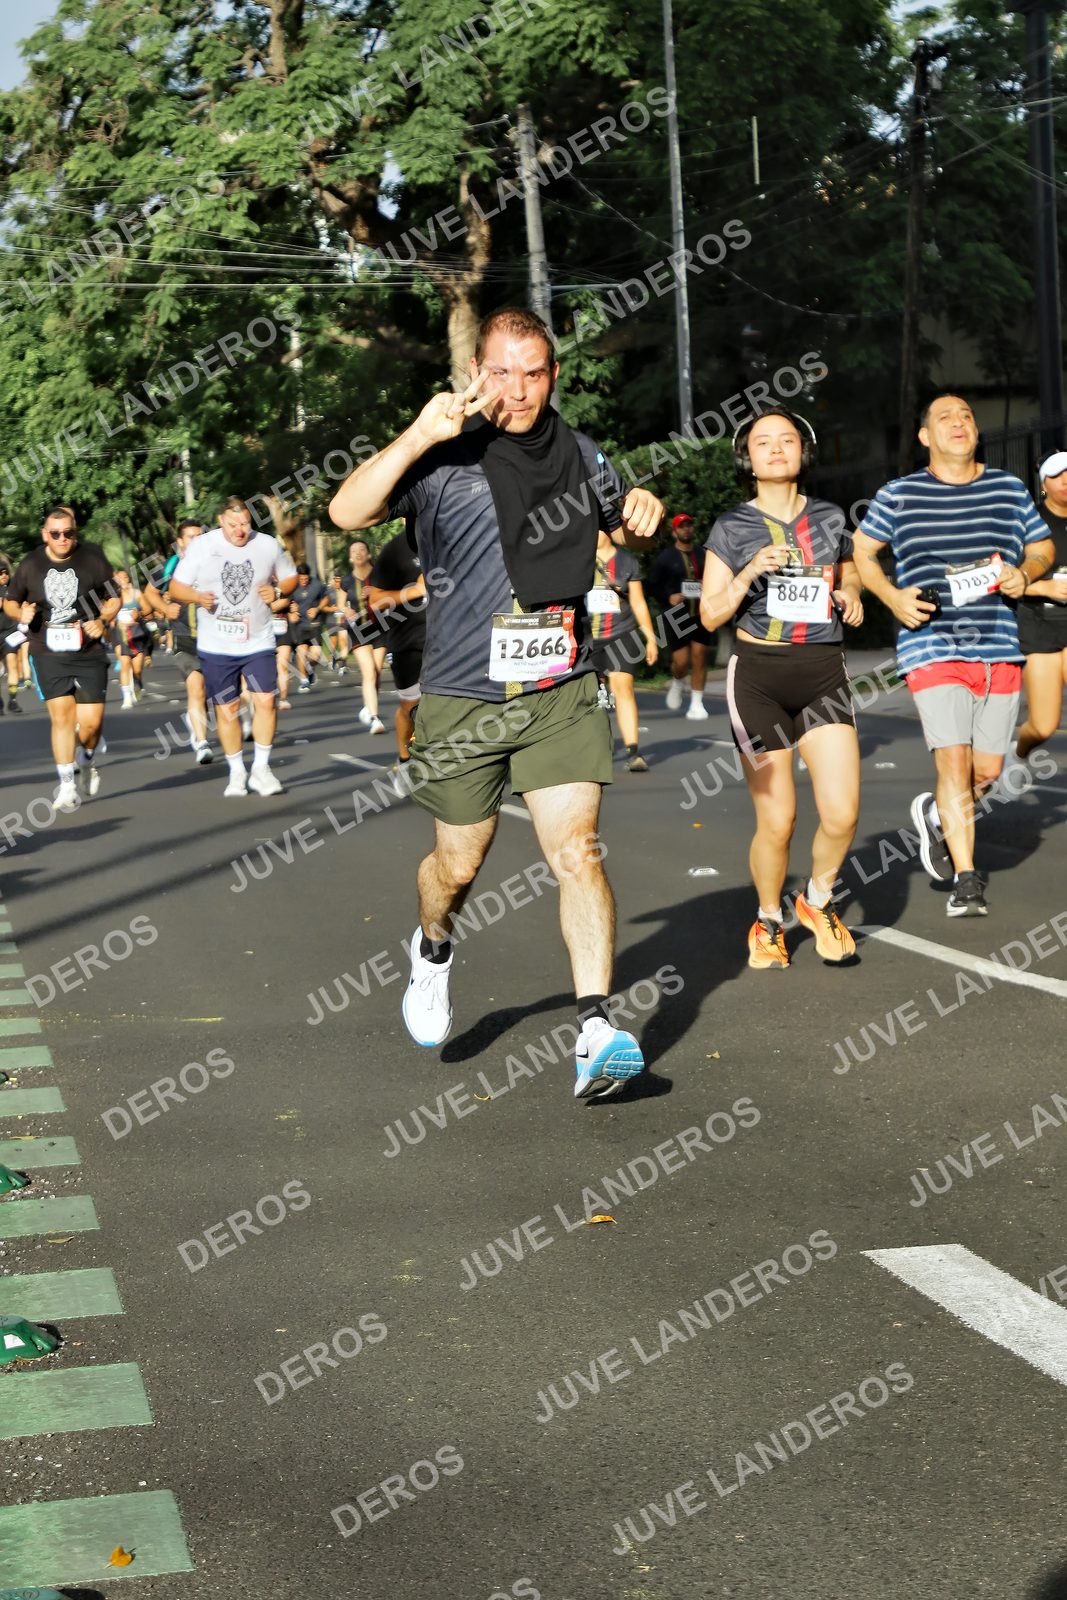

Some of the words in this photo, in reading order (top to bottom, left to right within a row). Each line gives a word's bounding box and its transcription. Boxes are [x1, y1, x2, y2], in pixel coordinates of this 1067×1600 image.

[778, 584, 820, 602] 8847
[217, 623, 245, 634] 11279
[497, 635, 567, 660] 12666
